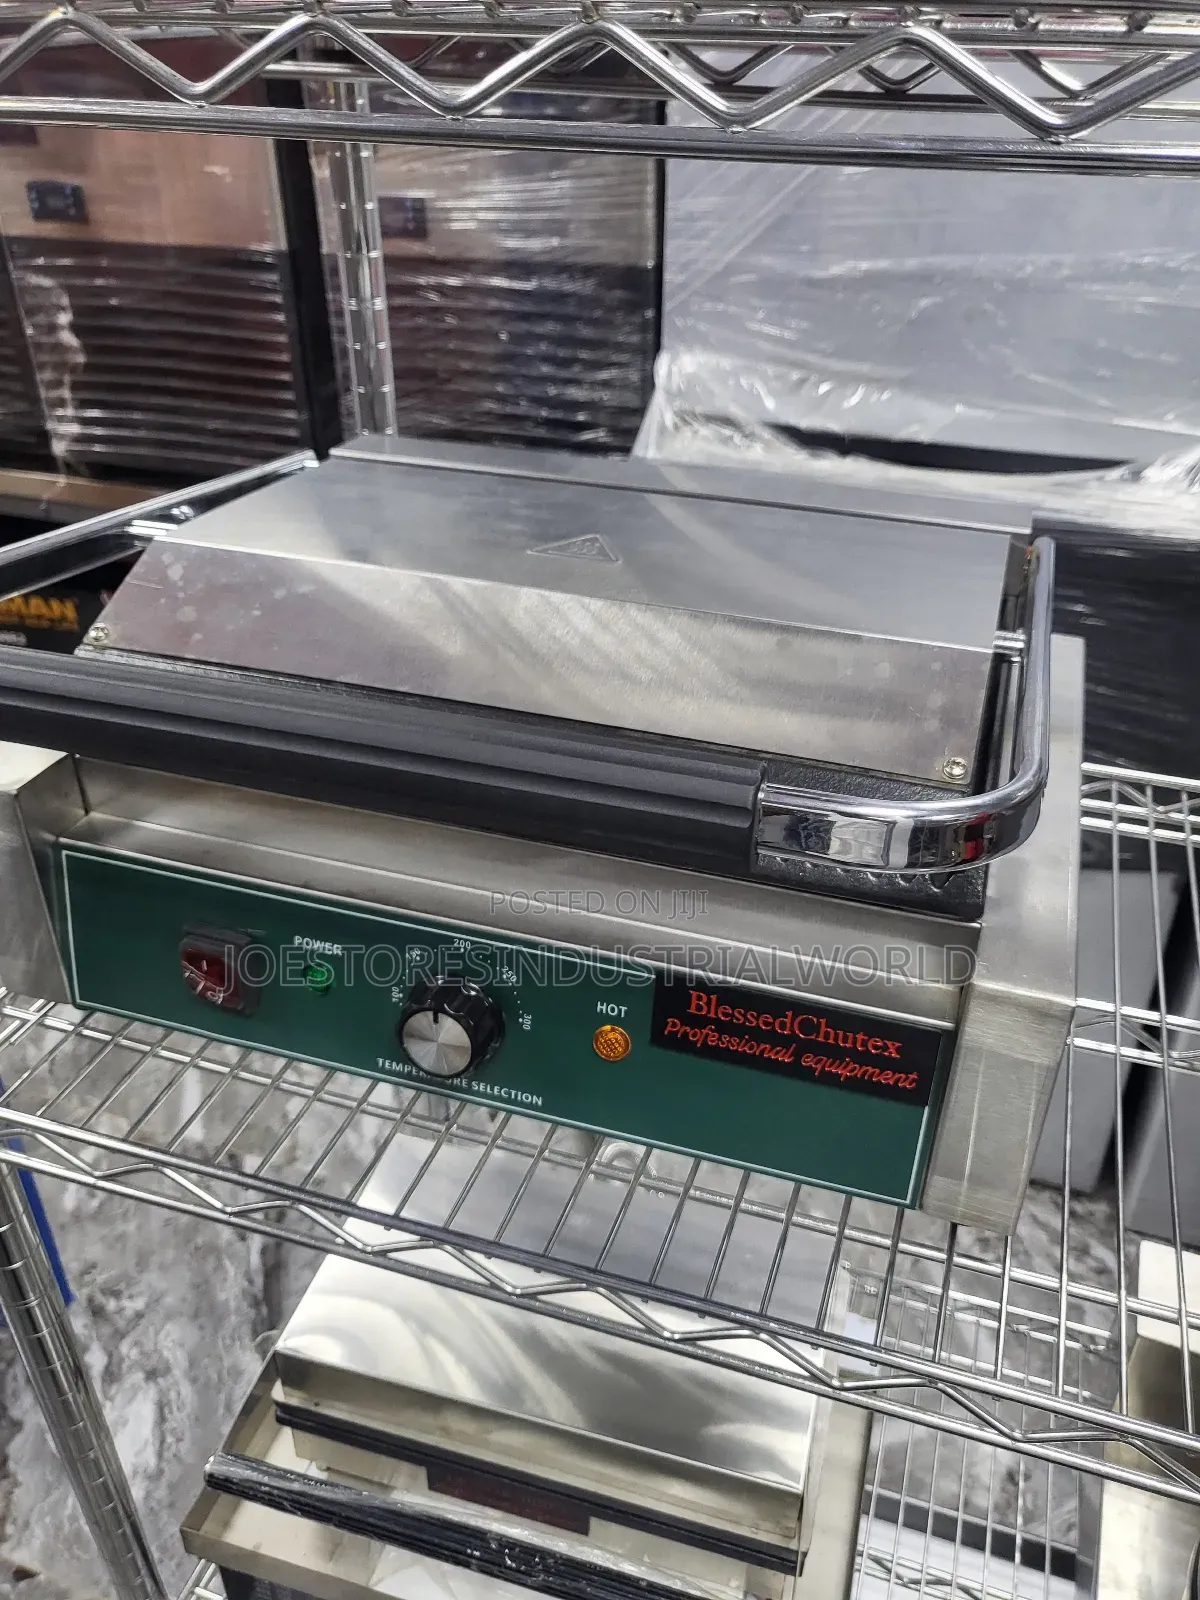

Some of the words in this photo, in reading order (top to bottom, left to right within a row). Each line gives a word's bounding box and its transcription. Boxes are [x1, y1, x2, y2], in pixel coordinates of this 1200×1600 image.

[293, 935, 343, 956] POWER
[453, 938, 472, 949] 200
[405, 947, 421, 961] 150
[501, 965, 517, 983] 250
[391, 986, 400, 1003] 100
[596, 1000, 628, 1018] HOT
[522, 1013, 532, 1030] 300
[686, 989, 903, 1058] BlessedChutex
[664, 1017, 797, 1063] Professional
[800, 1052, 920, 1090] equipment
[376, 1057, 469, 1089] TEMPERRE
[471, 1080, 543, 1106] SELECTION
